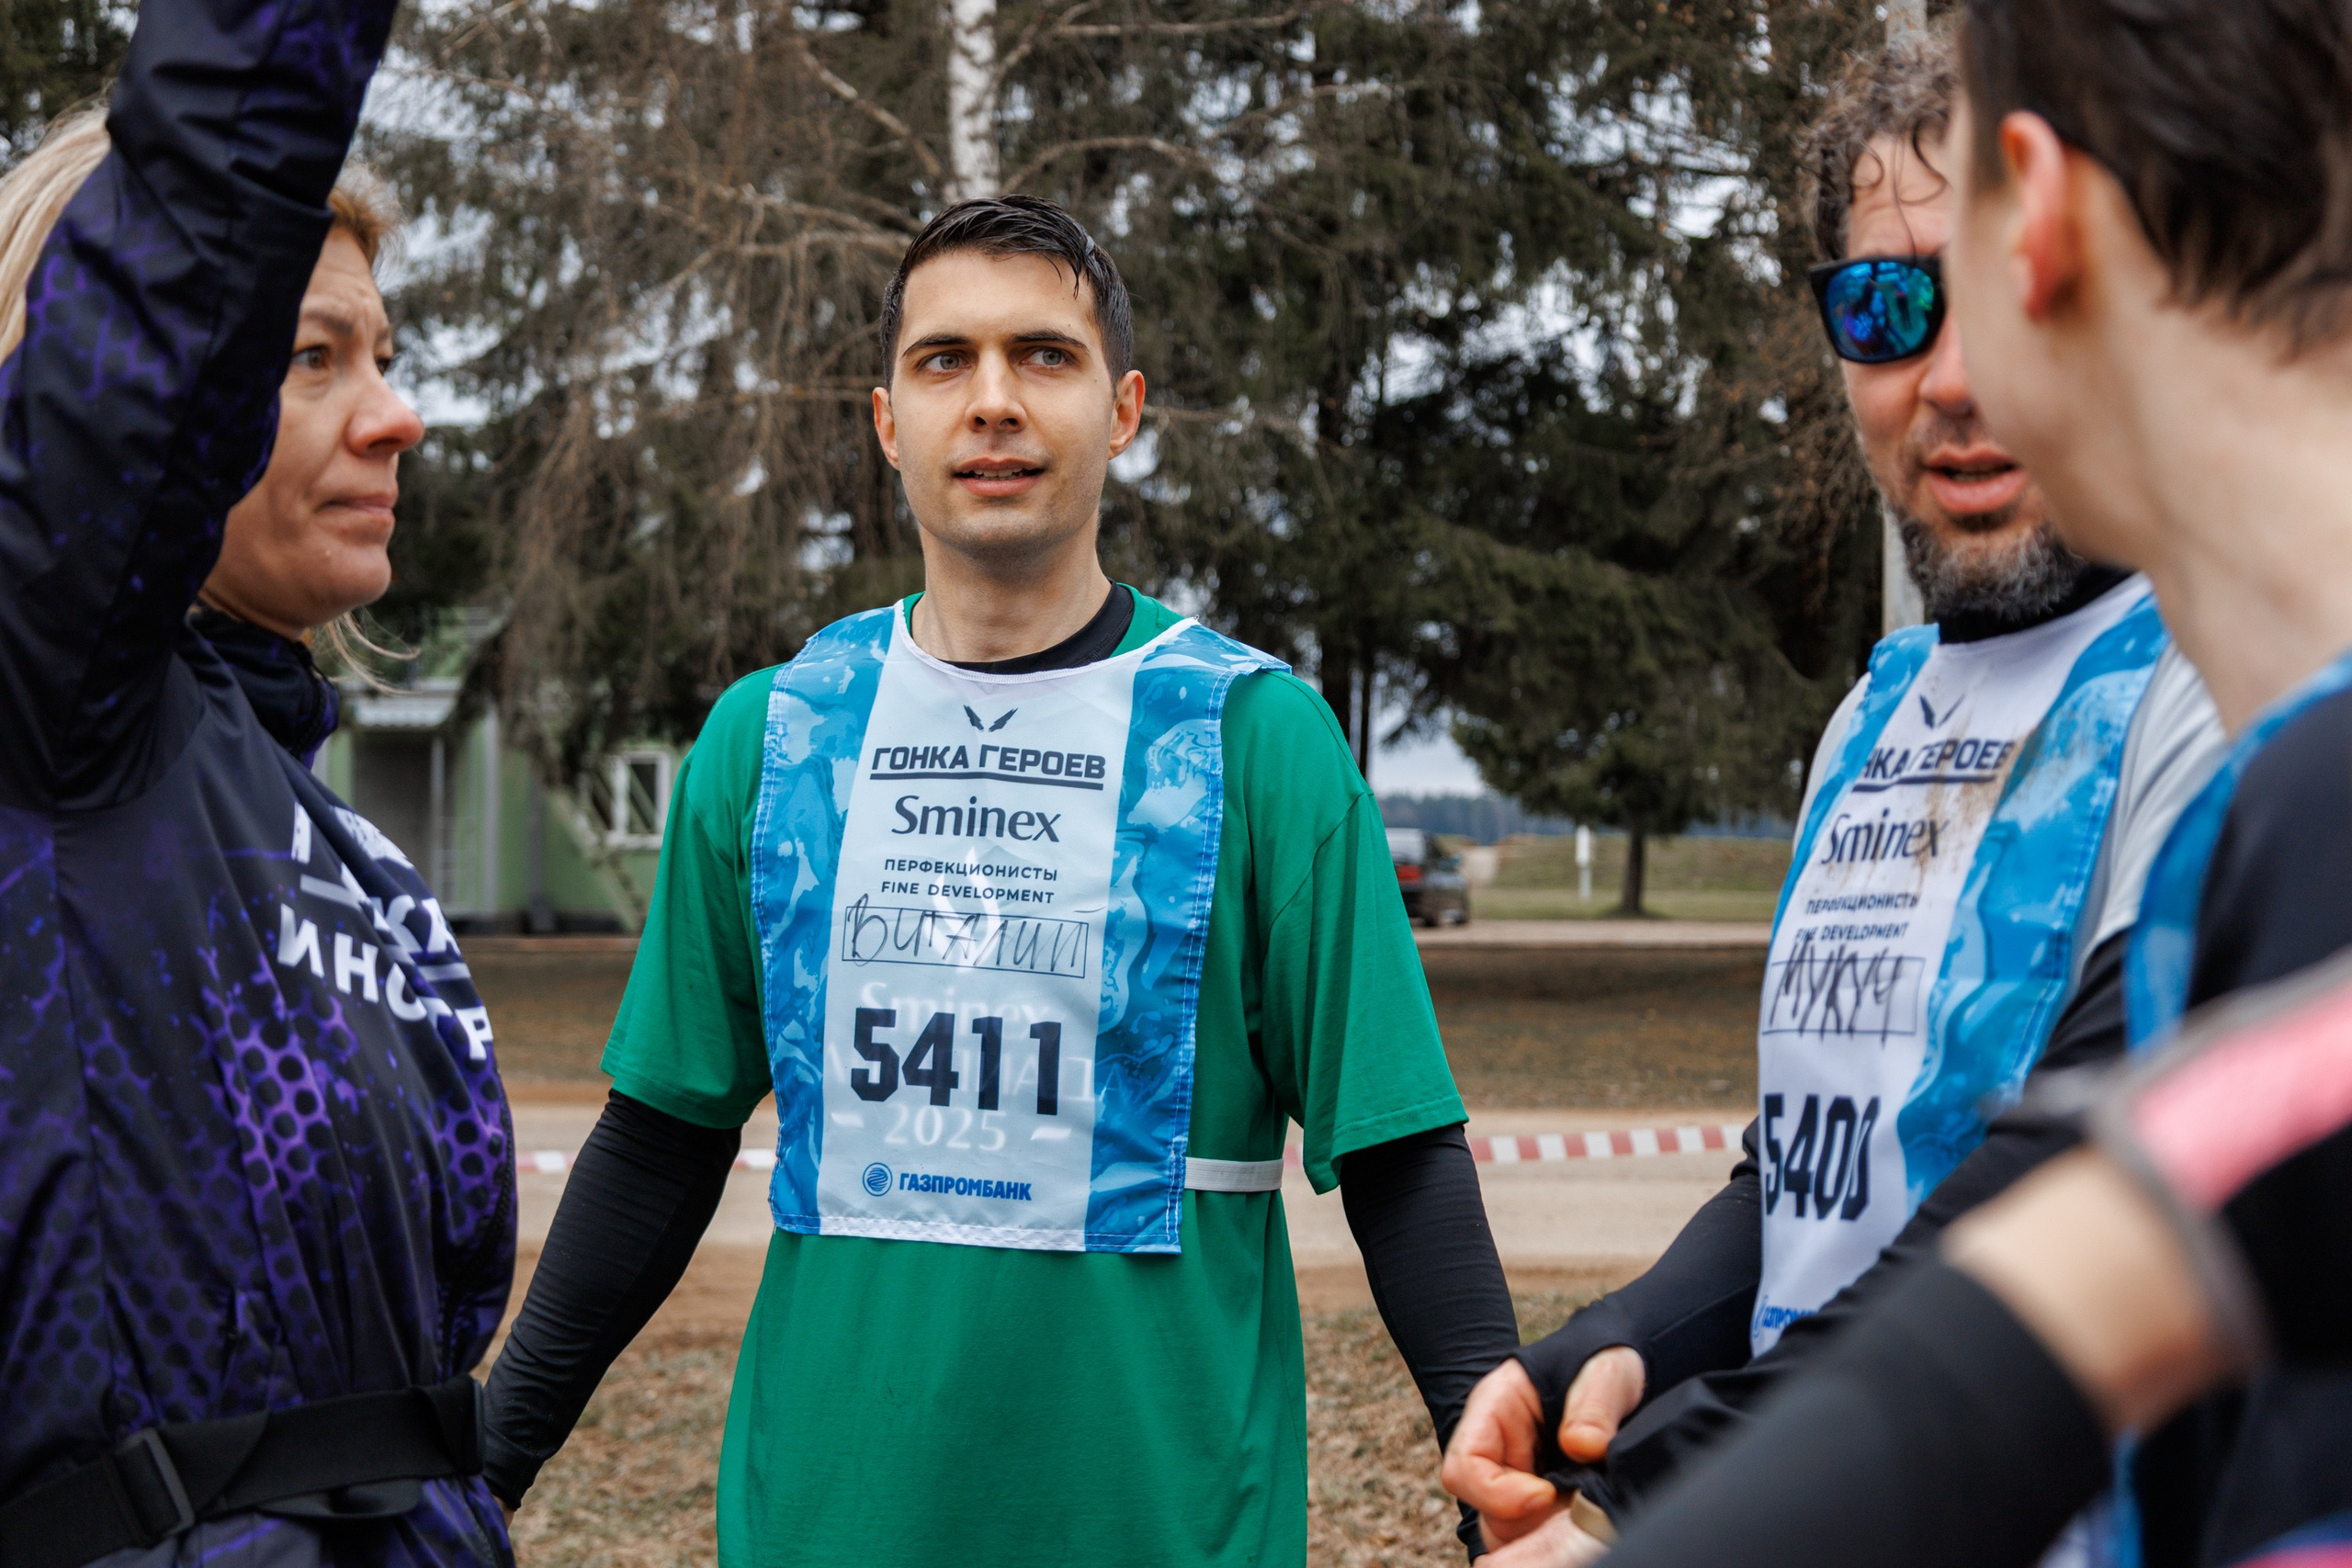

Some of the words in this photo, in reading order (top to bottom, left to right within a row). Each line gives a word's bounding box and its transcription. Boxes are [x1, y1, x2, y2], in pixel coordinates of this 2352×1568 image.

[871, 745, 969, 771] ГОНКА
[978, 744, 1106, 779] ГЕРОЕВ
[891, 795, 1062, 842] Sminex
[1821, 807, 1951, 864] Sminex
[884, 858, 1057, 882] ПЕРФЕКЦИОНИСТЫ
[881, 881, 920, 895] FINE
[928, 884, 1055, 904] DEVELOPMENT
[1820, 921, 1909, 941] DEVELOPMENT
[851, 1007, 1062, 1116] 5411
[883, 1100, 1008, 1152] 2025
[899, 1172, 1032, 1201] ГАЗПРОМБАНК
